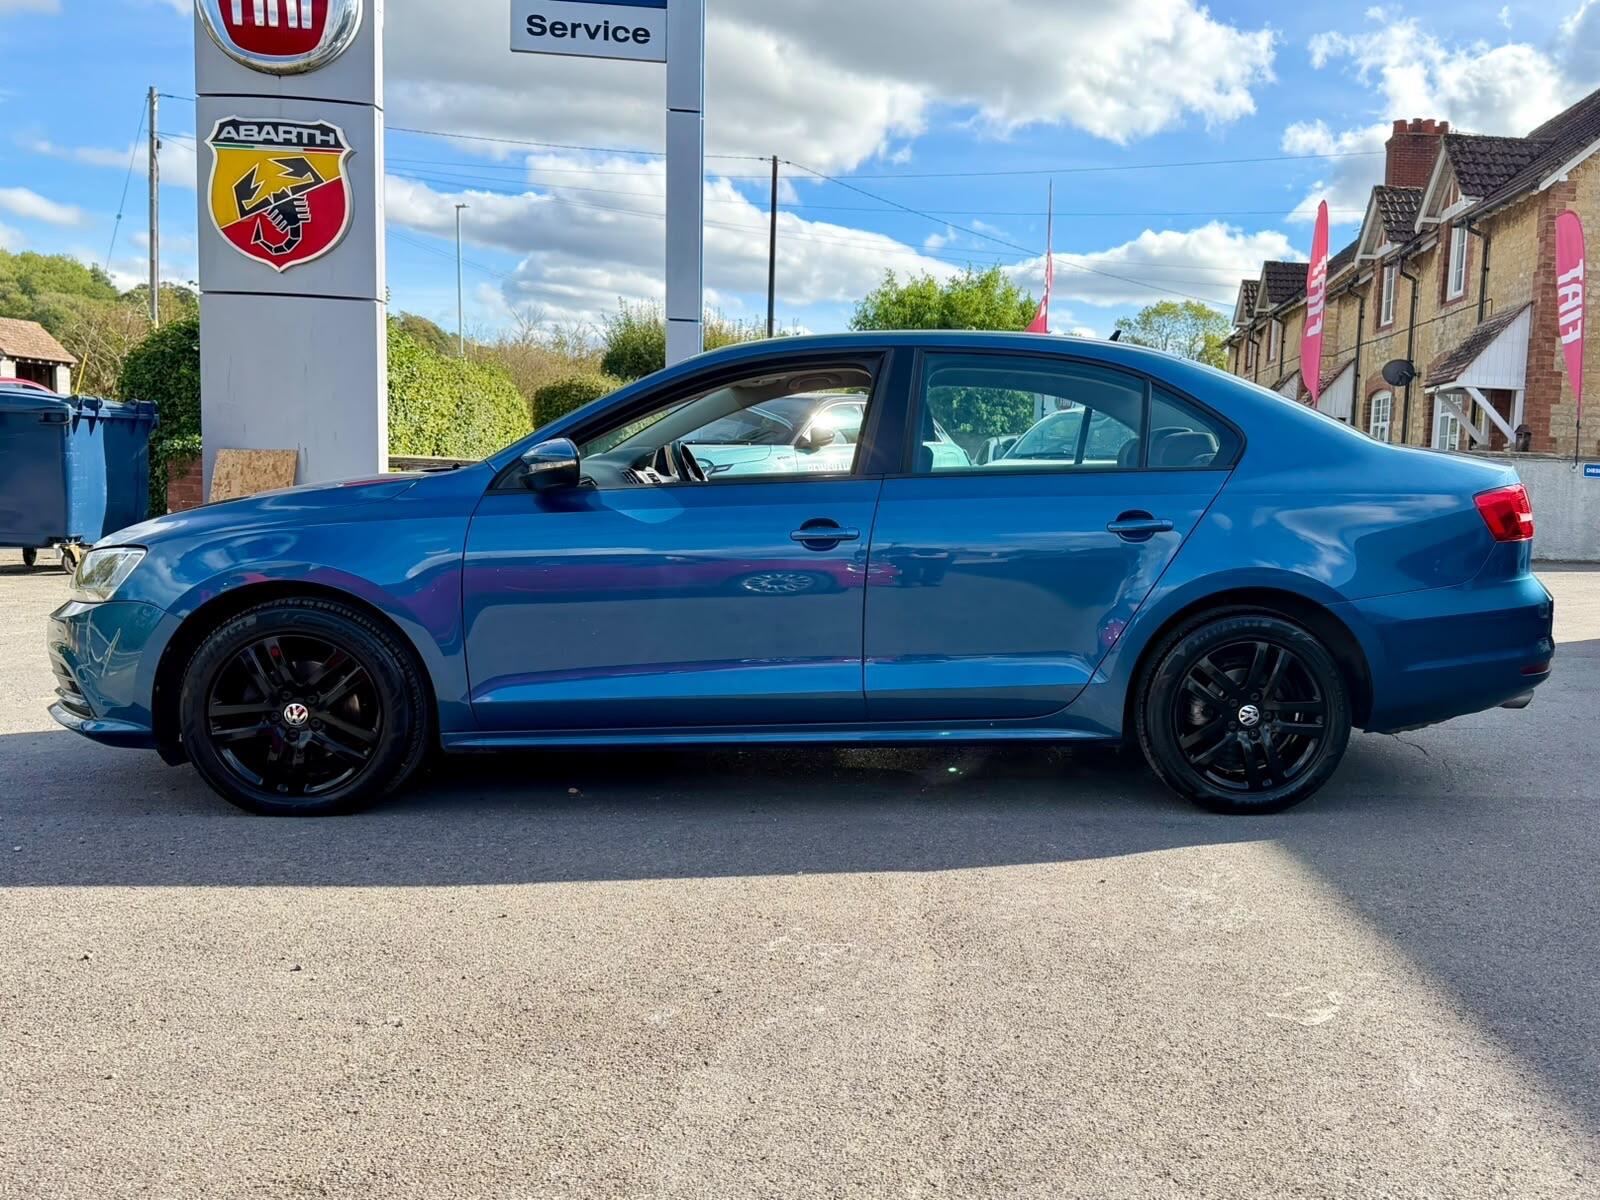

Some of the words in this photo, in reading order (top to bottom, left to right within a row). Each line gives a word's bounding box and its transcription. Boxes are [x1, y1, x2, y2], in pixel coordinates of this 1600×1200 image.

[526, 14, 651, 44] Service
[217, 125, 336, 145] ABARTH
[1557, 258, 1584, 345] FIAT
